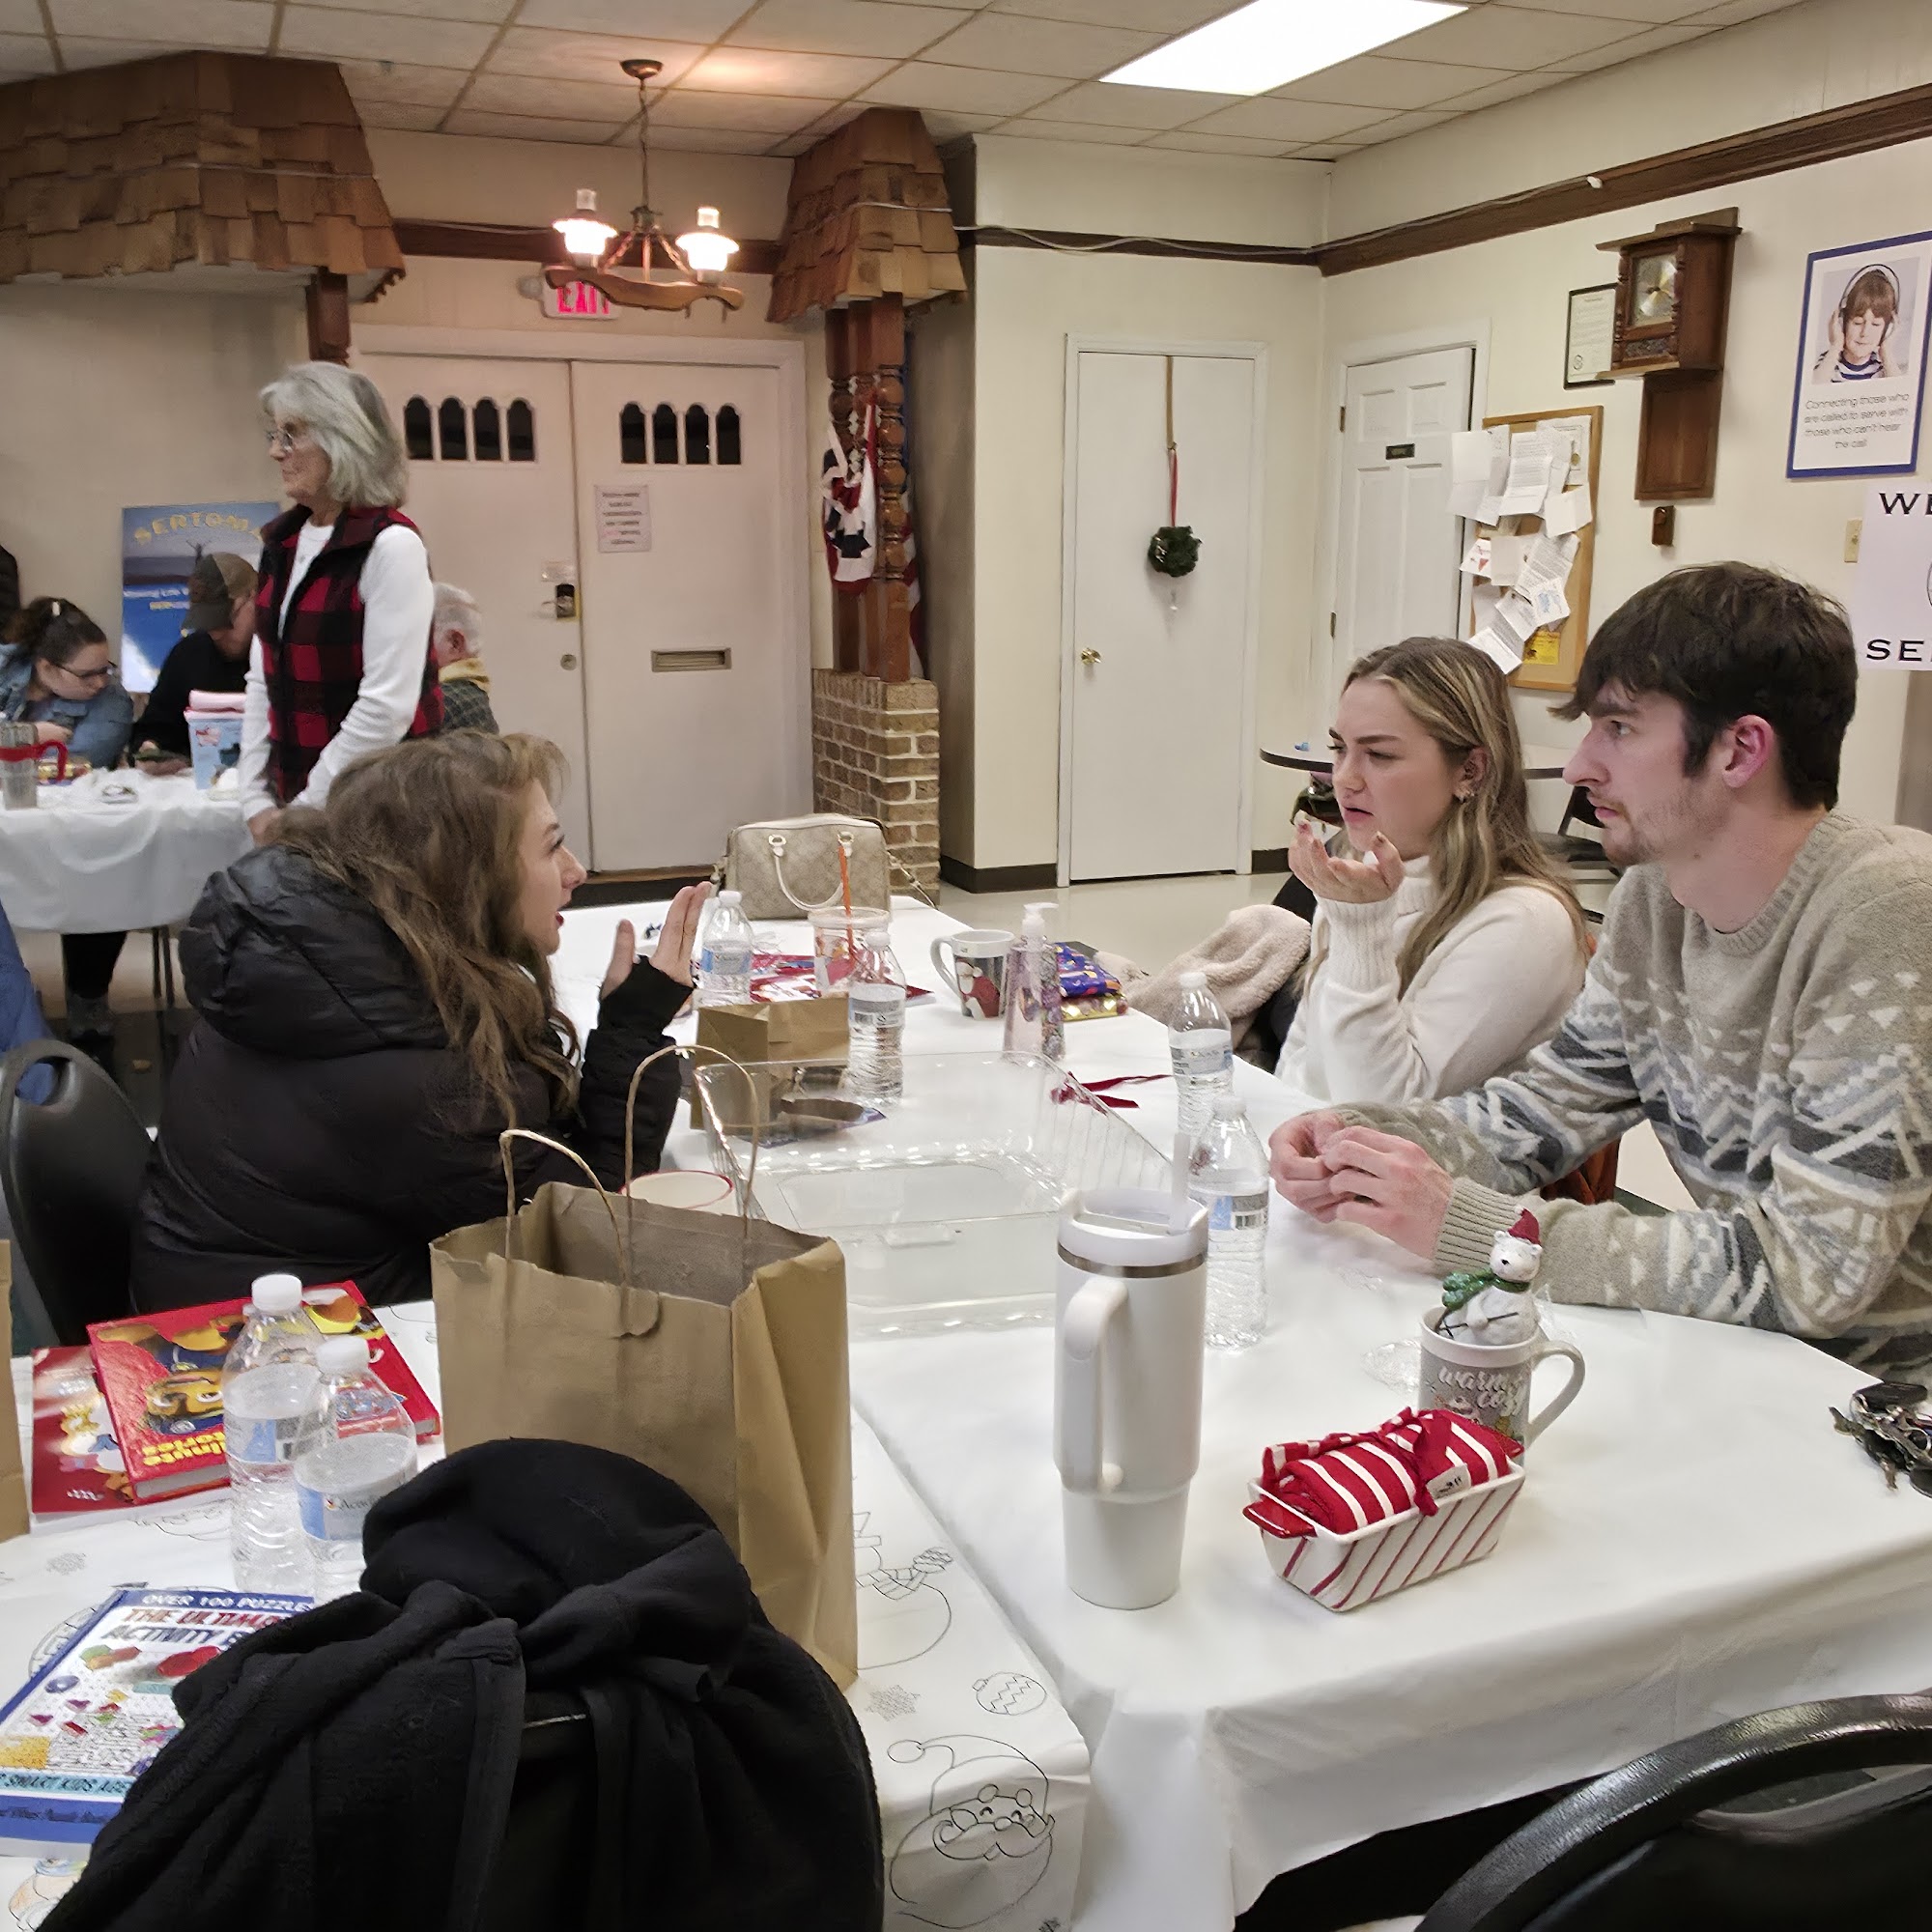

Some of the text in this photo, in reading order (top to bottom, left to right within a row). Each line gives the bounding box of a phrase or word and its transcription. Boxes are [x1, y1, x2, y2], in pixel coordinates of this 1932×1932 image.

[556, 279, 610, 315] EXI
[1805, 393, 1909, 409] Connecting those who
[1879, 493, 1932, 516] W
[1866, 639, 1932, 662] SE
